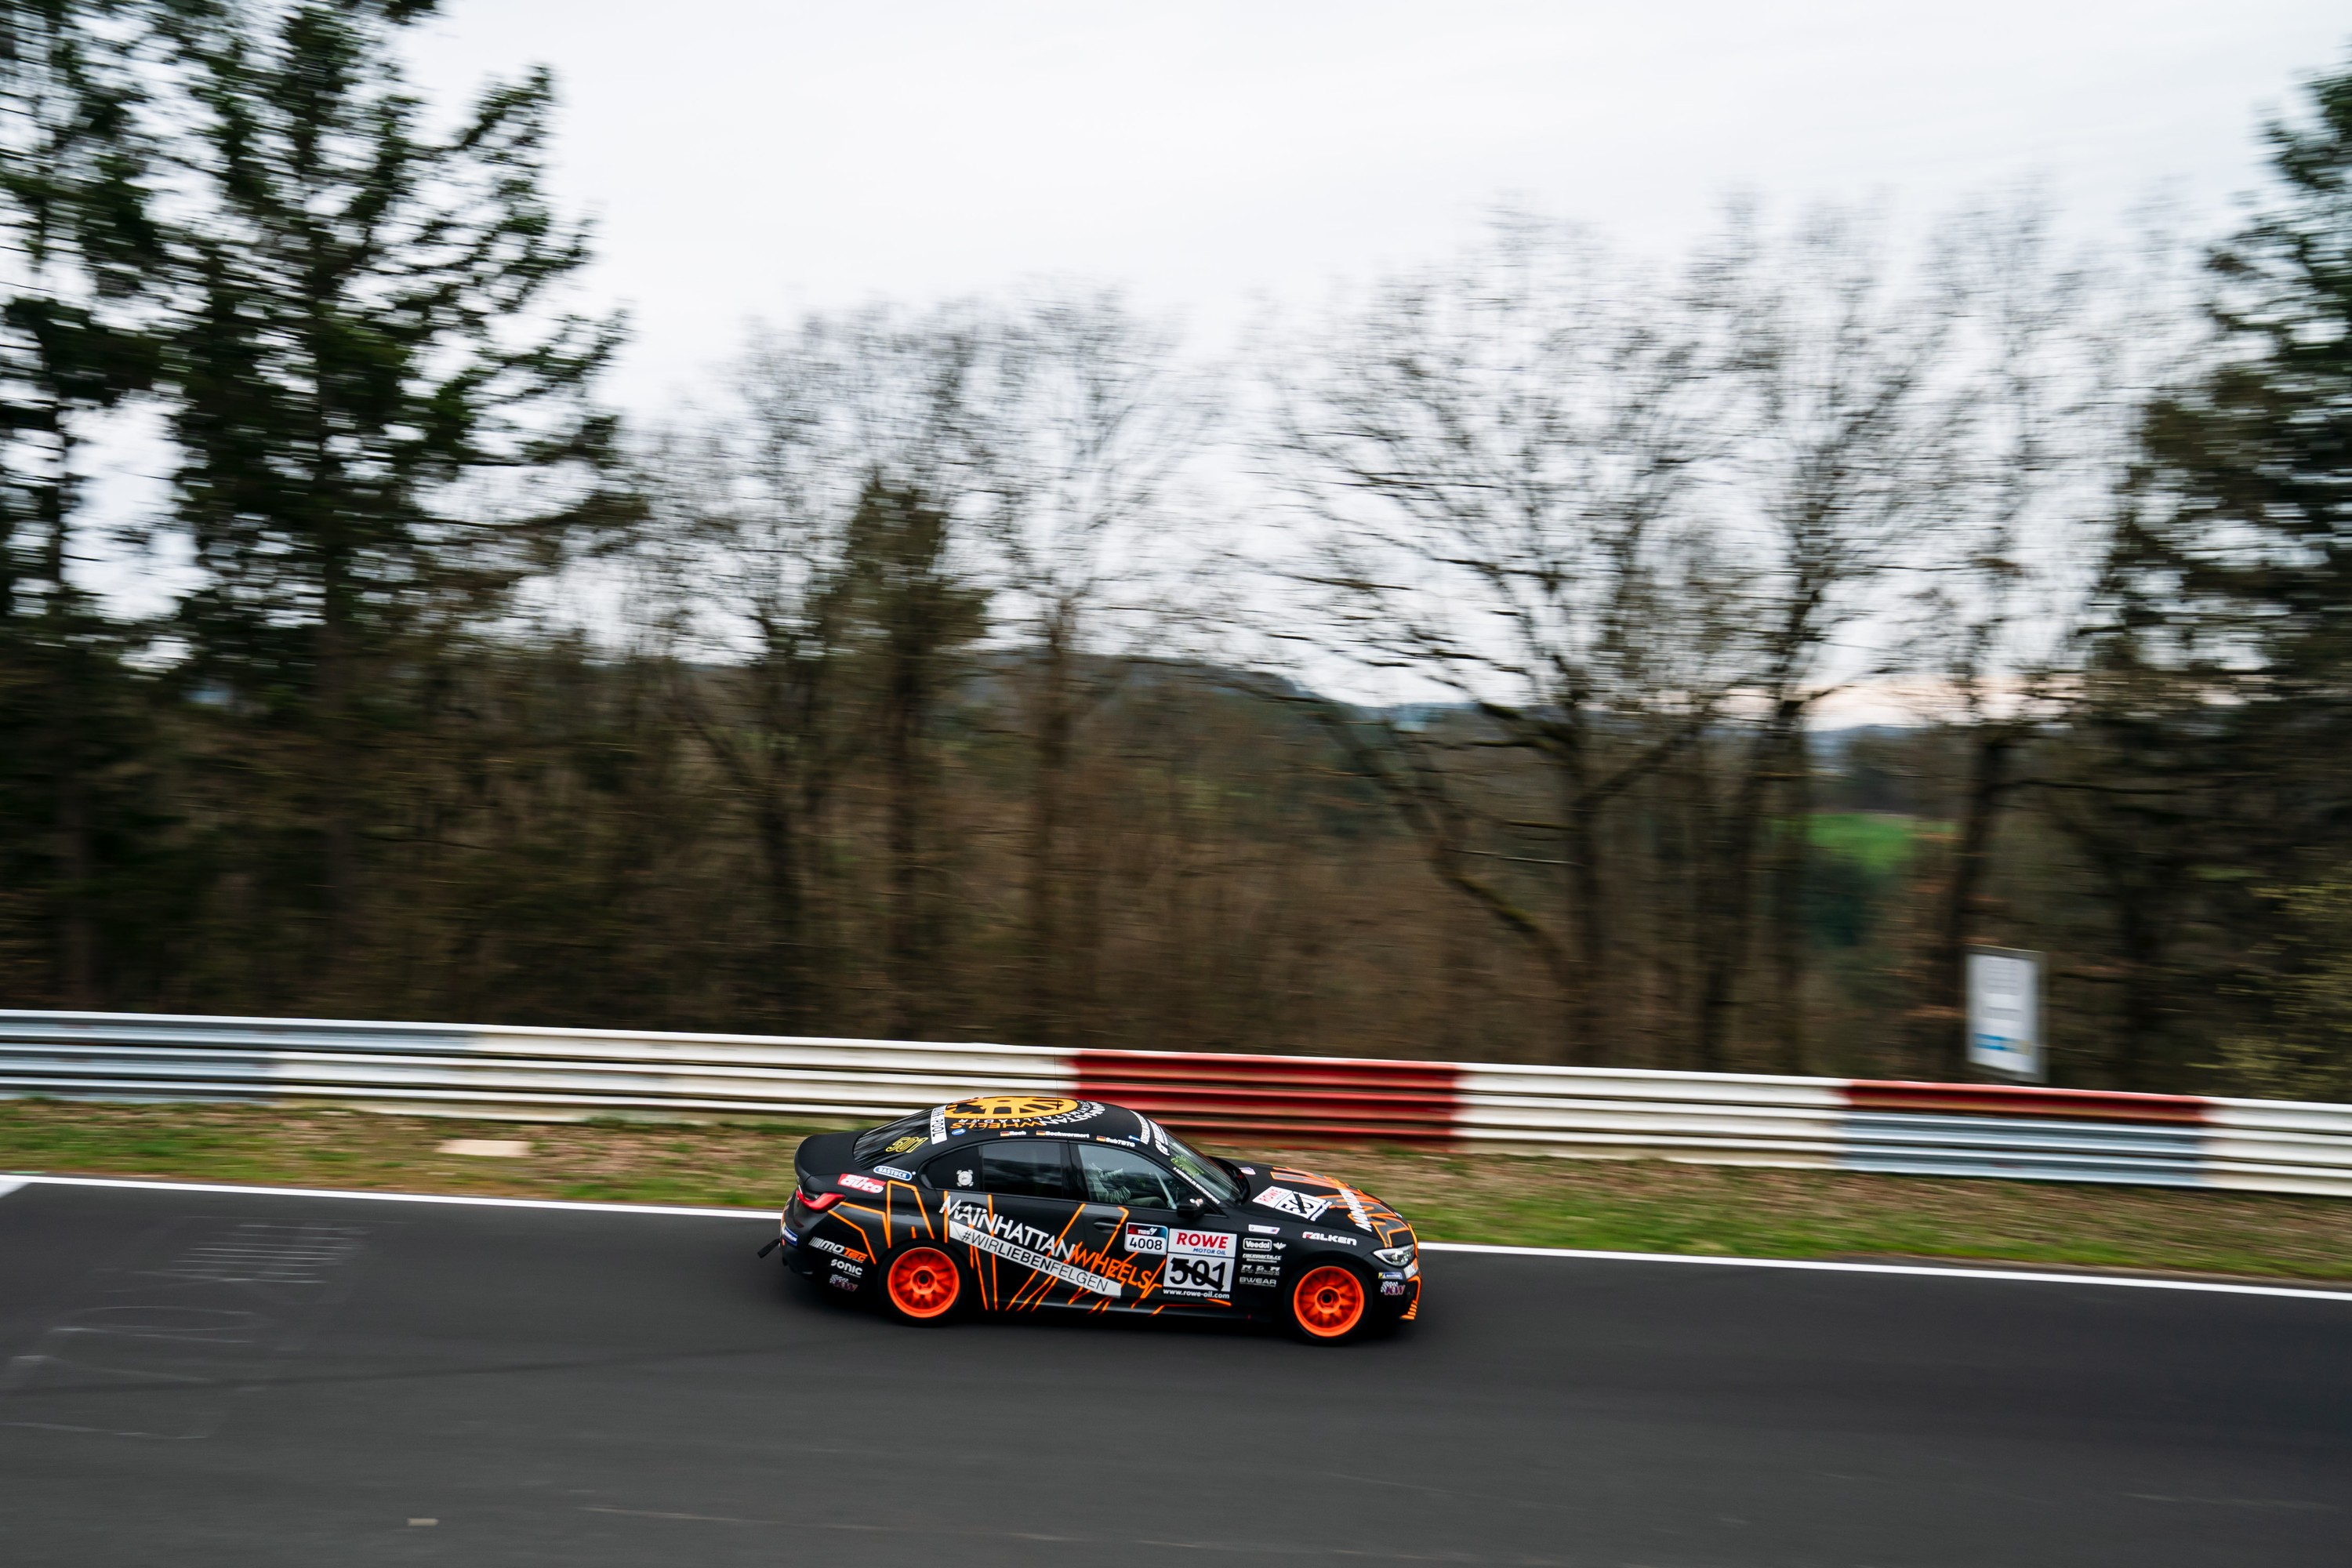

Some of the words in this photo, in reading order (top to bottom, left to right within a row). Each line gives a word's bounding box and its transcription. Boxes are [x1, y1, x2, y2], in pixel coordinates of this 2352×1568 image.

[885, 1136, 928, 1153] 501
[878, 1167, 907, 1178] BASTUCK
[840, 1178, 884, 1193] auto
[1129, 1237, 1163, 1250] 4008
[1177, 1232, 1229, 1249] ROWE
[1246, 1240, 1270, 1249] Veedol
[1302, 1231, 1357, 1246] FALKEN
[961, 1230, 1109, 1292] #WIRLIEBENFELGEN
[1170, 1258, 1226, 1288] 501
[1163, 1288, 1230, 1299] www.rowe-oil.com
